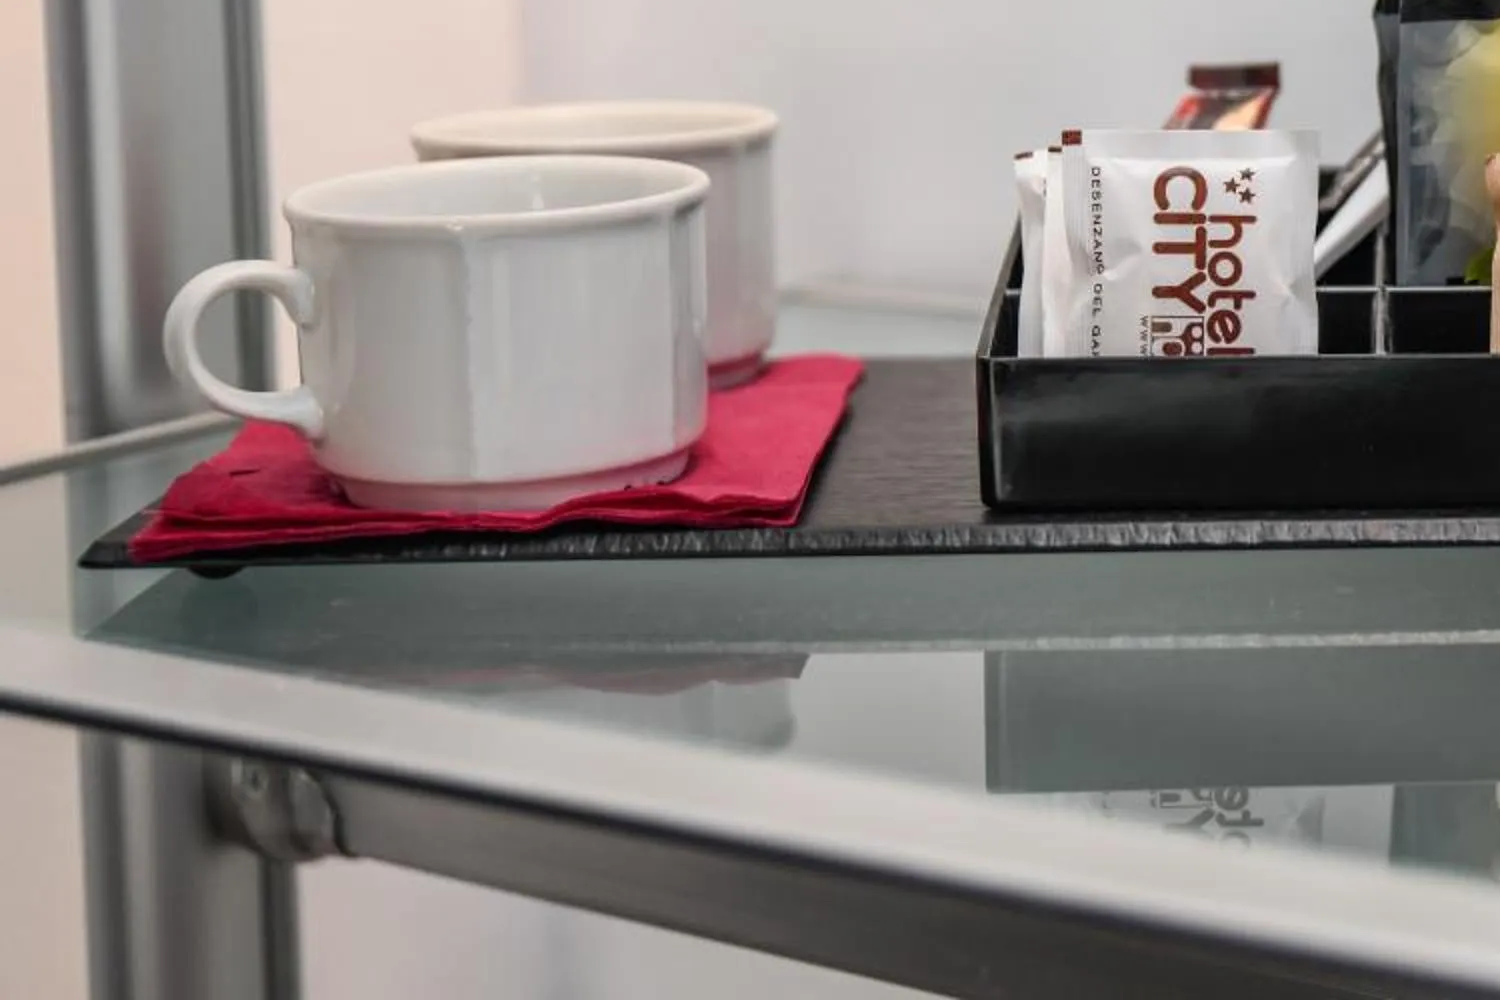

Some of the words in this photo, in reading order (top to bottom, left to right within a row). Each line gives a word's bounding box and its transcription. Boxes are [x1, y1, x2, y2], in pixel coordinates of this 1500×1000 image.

[1091, 166, 1105, 276] DESENZANO
[1152, 165, 1208, 315] CITY
[1091, 283, 1103, 318] DEL
[1206, 214, 1257, 356] hotel
